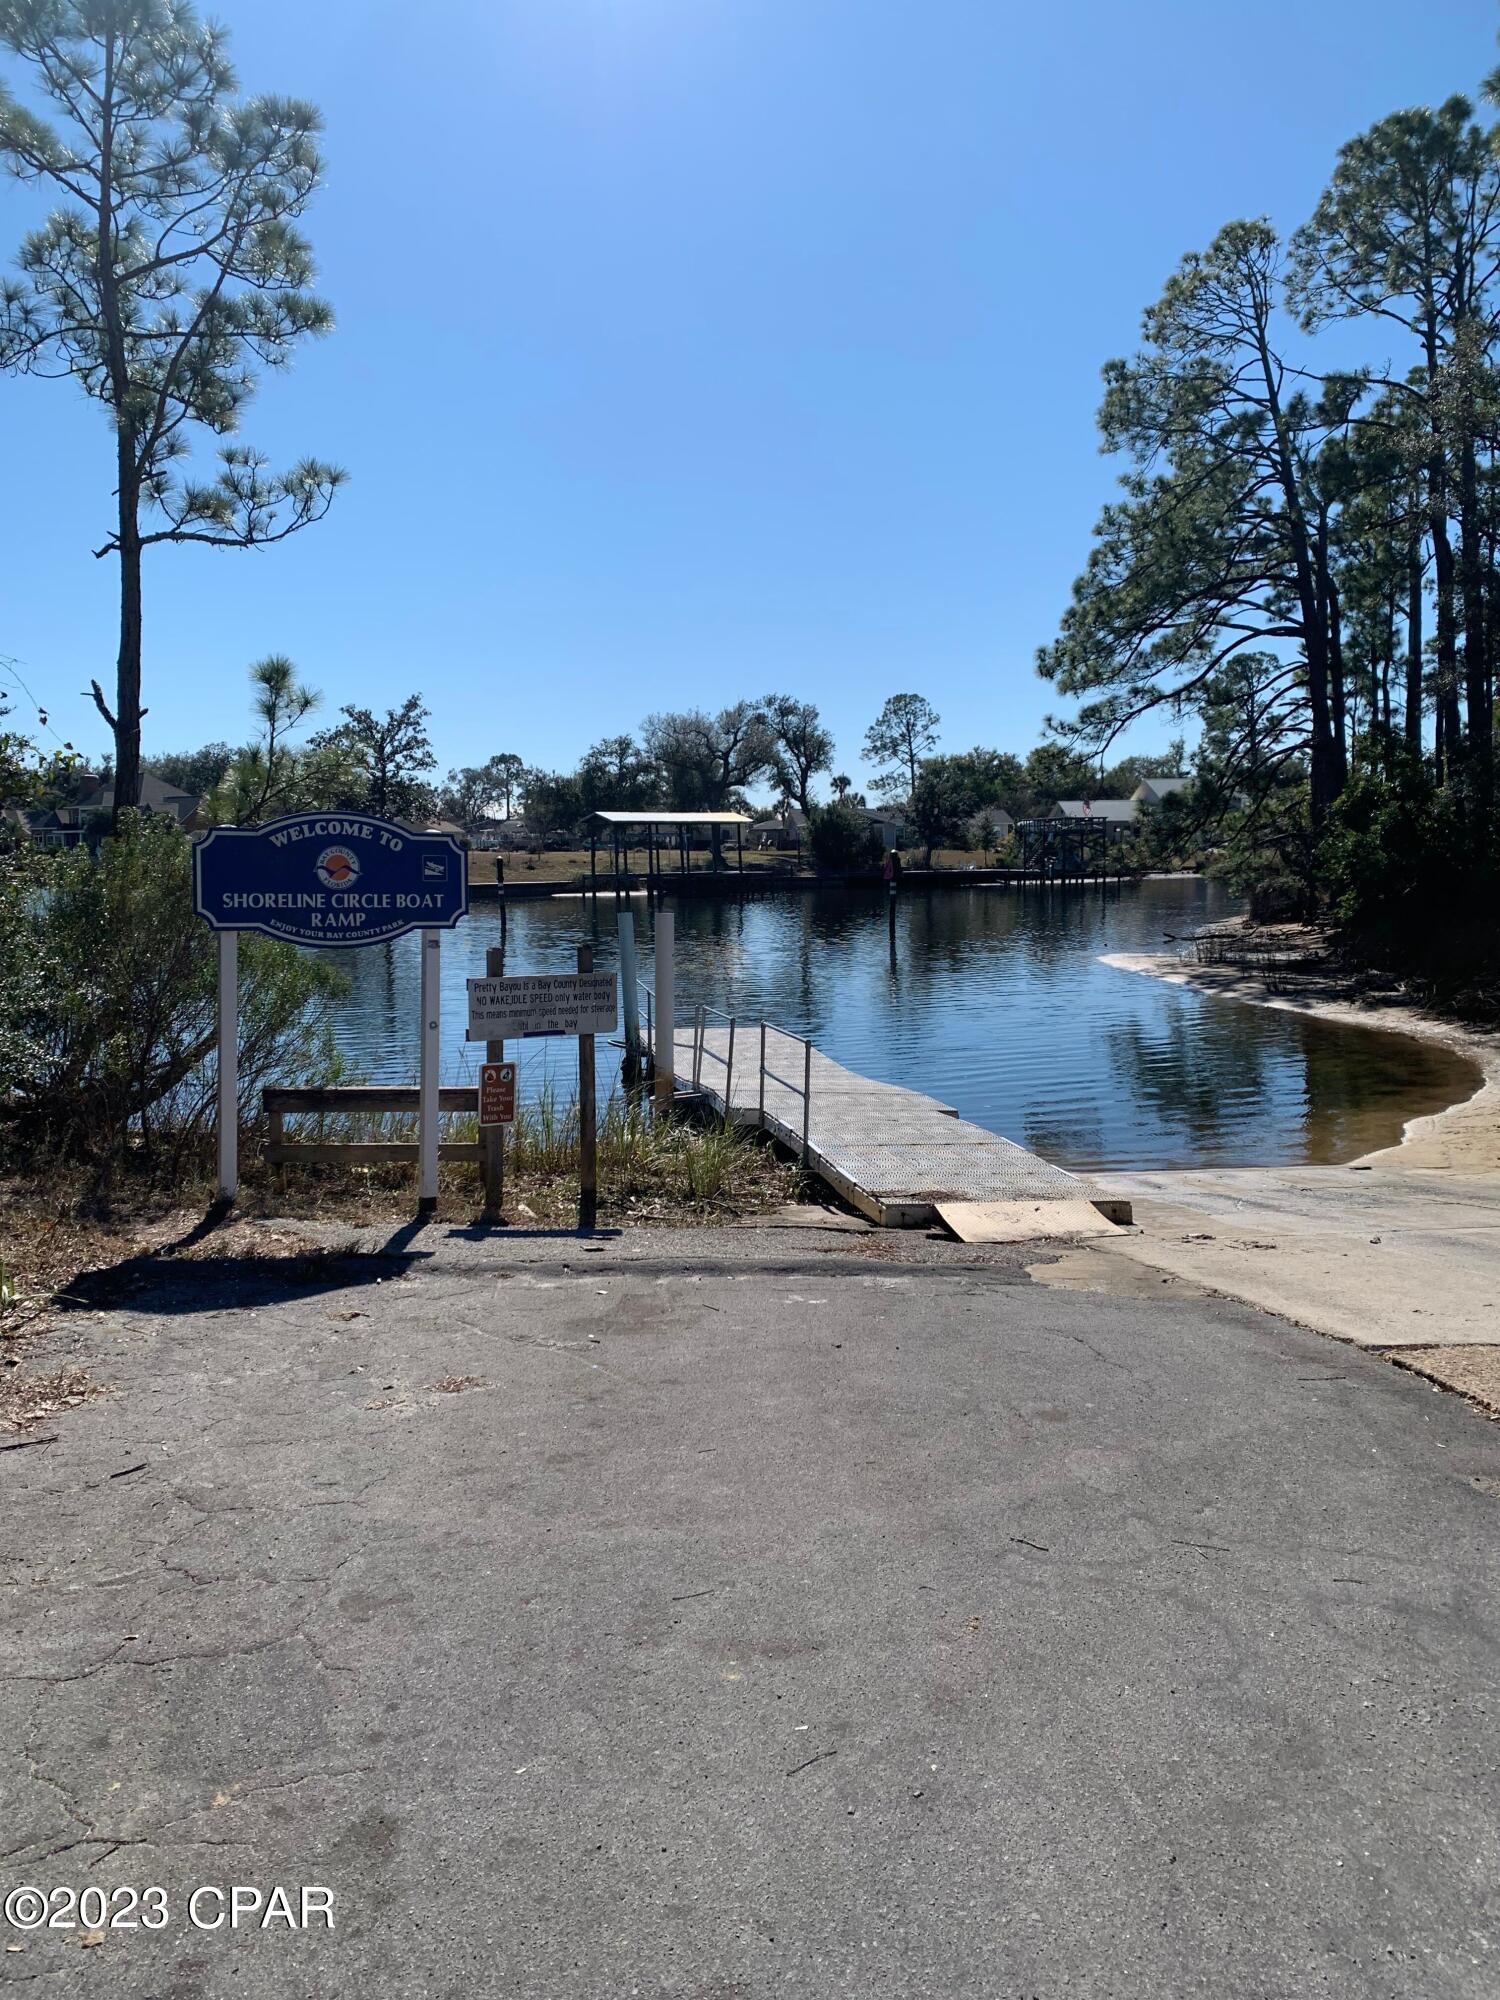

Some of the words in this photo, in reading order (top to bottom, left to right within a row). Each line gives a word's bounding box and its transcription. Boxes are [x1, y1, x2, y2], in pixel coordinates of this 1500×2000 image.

[268, 821, 373, 848] WELCOME
[380, 833, 403, 852] TO
[222, 893, 326, 909] SHORELINE
[331, 893, 390, 909] CIRCLE
[395, 893, 444, 909] BOAT
[311, 912, 366, 928] RAMP
[269, 918, 298, 933] ENJOY
[299, 928, 325, 939] YOUR
[345, 928, 381, 938] COUNTY
[382, 919, 405, 932] PARK
[474, 983, 497, 994] Pretty
[499, 982, 522, 994] Bayou
[538, 980, 551, 992] Bay
[554, 980, 577, 991] County
[579, 978, 613, 988] Designated
[477, 996, 487, 1006] NO
[530, 993, 553, 1003] SPEED
[555, 993, 570, 1003] only
[573, 992, 592, 1001] water
[593, 992, 610, 1002] body
[472, 1010, 485, 1020] This
[486, 1010, 507, 1019] means
[509, 1009, 537, 1018] minimum
[558, 1006, 579, 1015] needed
[580, 1005, 589, 1014] for
[591, 1004, 616, 1014] steerage
[547, 1019, 559, 1029] the
[564, 1019, 578, 1030] bay
